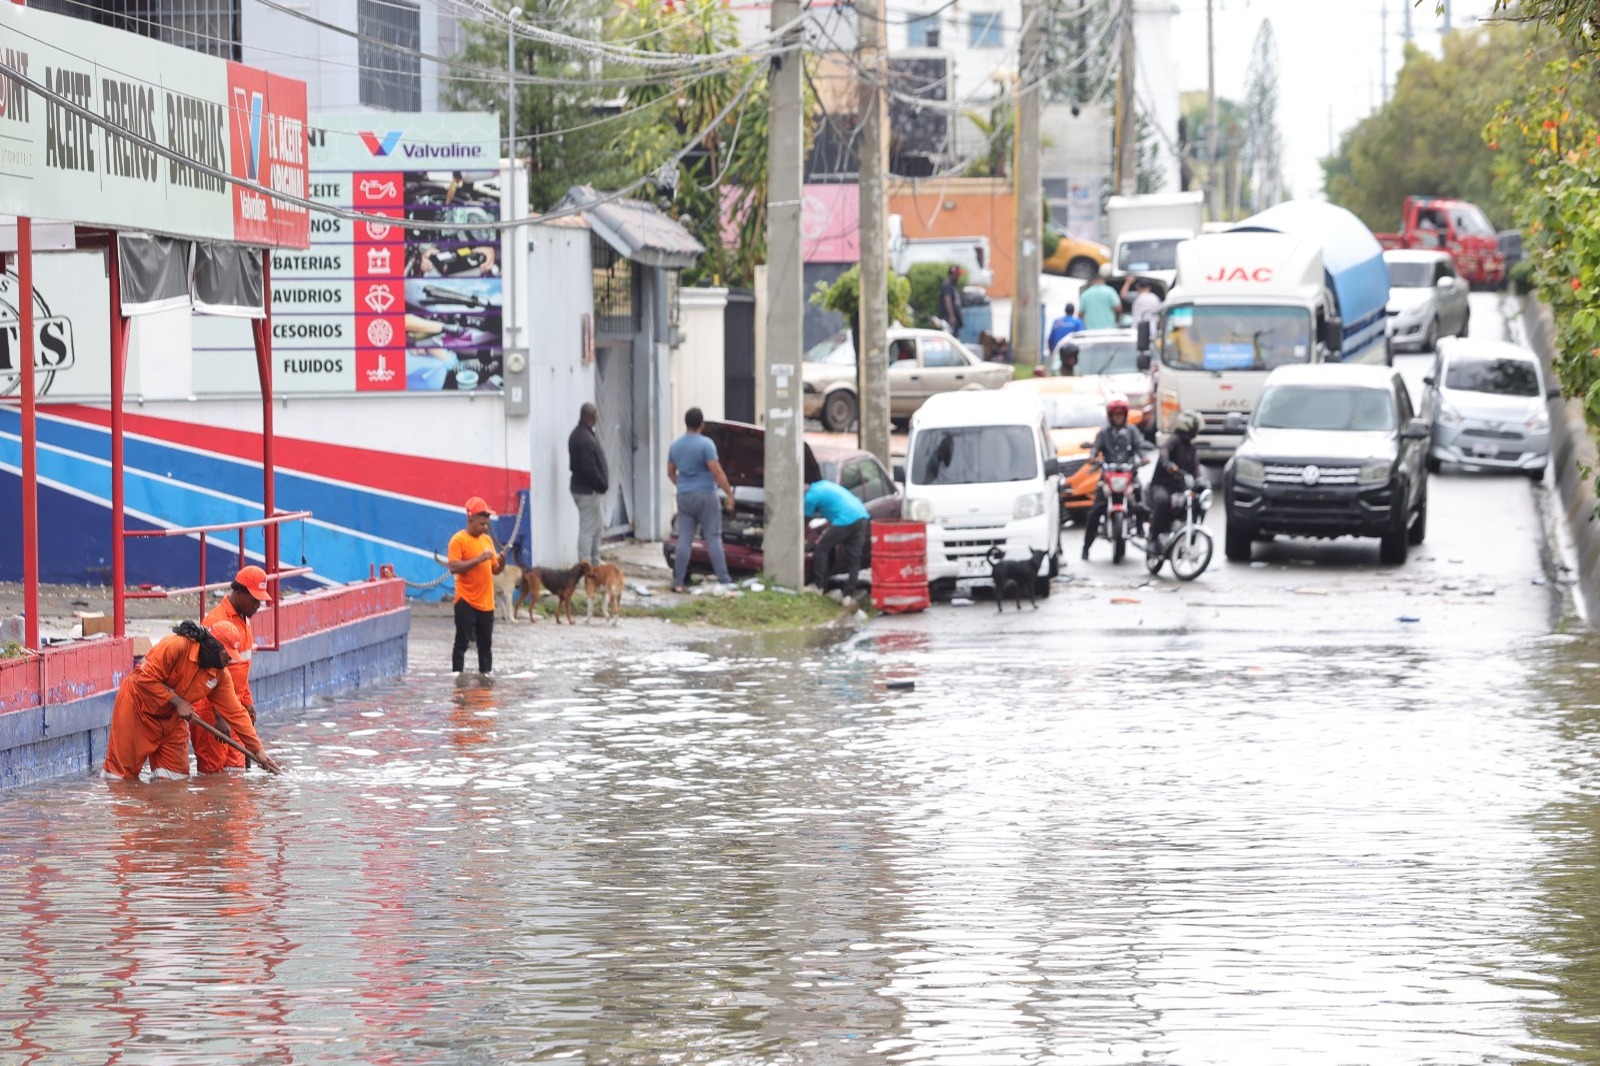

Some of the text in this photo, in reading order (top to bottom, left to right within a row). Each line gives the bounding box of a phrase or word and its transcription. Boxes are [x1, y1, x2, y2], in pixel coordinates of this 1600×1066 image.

[46, 66, 94, 172] ACEITE
[102, 78, 157, 183] FRENOS
[166, 92, 225, 194] BATERIAS
[279, 115, 303, 165] ACEITE
[403, 143, 482, 158] Valvoline
[270, 164, 306, 214] ORIGINAL
[240, 190, 267, 222] Valvoline
[311, 219, 341, 232] NOS
[273, 256, 341, 270] BATERIAS
[1206, 267, 1273, 282] JAC
[272, 288, 342, 303] AVIDRIOS
[273, 324, 342, 338] CESORIOS
[284, 360, 343, 373] FLUIDOS
